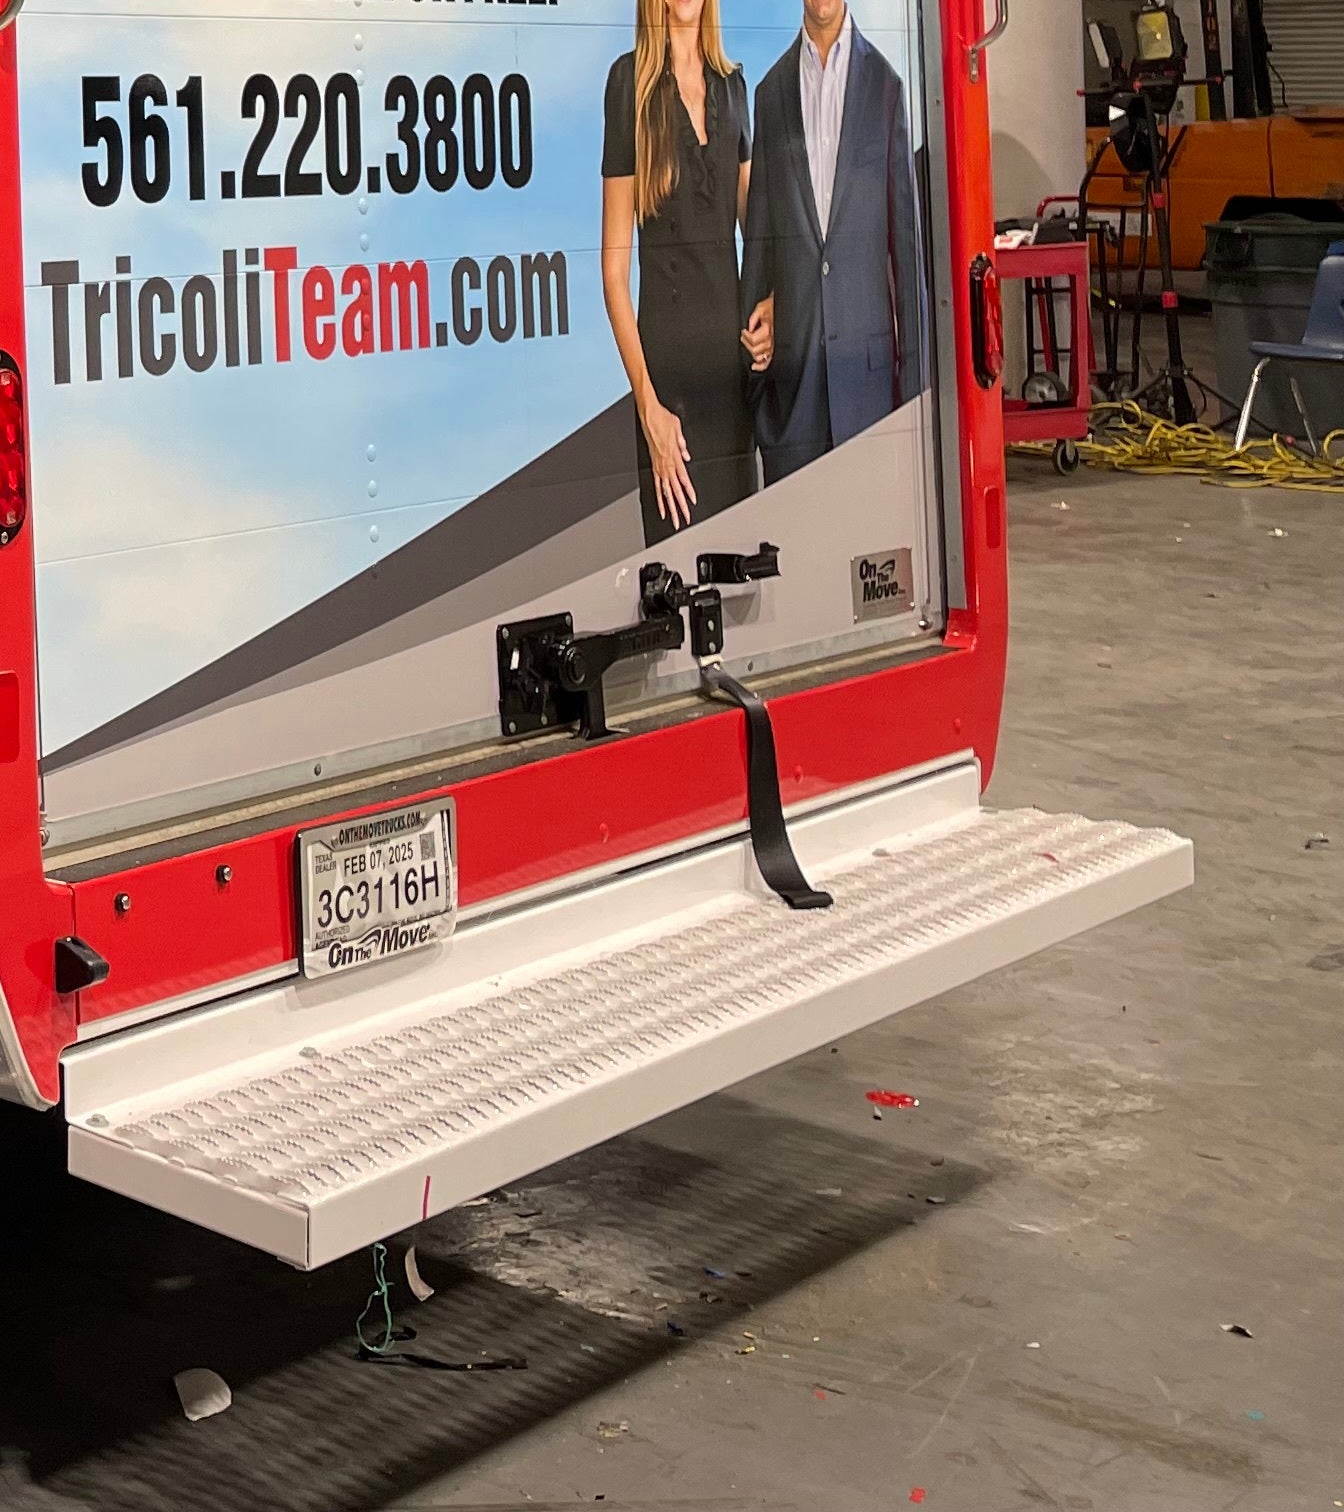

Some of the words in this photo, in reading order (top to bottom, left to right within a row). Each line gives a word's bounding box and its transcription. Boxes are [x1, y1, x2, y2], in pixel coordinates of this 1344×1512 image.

[81, 72, 534, 208] 561.220.3800
[40, 245, 570, 385] TricoliTeam.com
[859, 559, 877, 580] On
[863, 580, 898, 603] Move
[315, 852, 334, 865] TEXAS
[315, 861, 337, 874] DEALER
[344, 854, 366, 877] FEB
[369, 849, 386, 870] 07,
[389, 842, 413, 865] 2025
[317, 861, 440, 928] 3C3116H
[328, 942, 353, 968] On
[355, 947, 372, 962] The
[380, 925, 429, 955] Move
